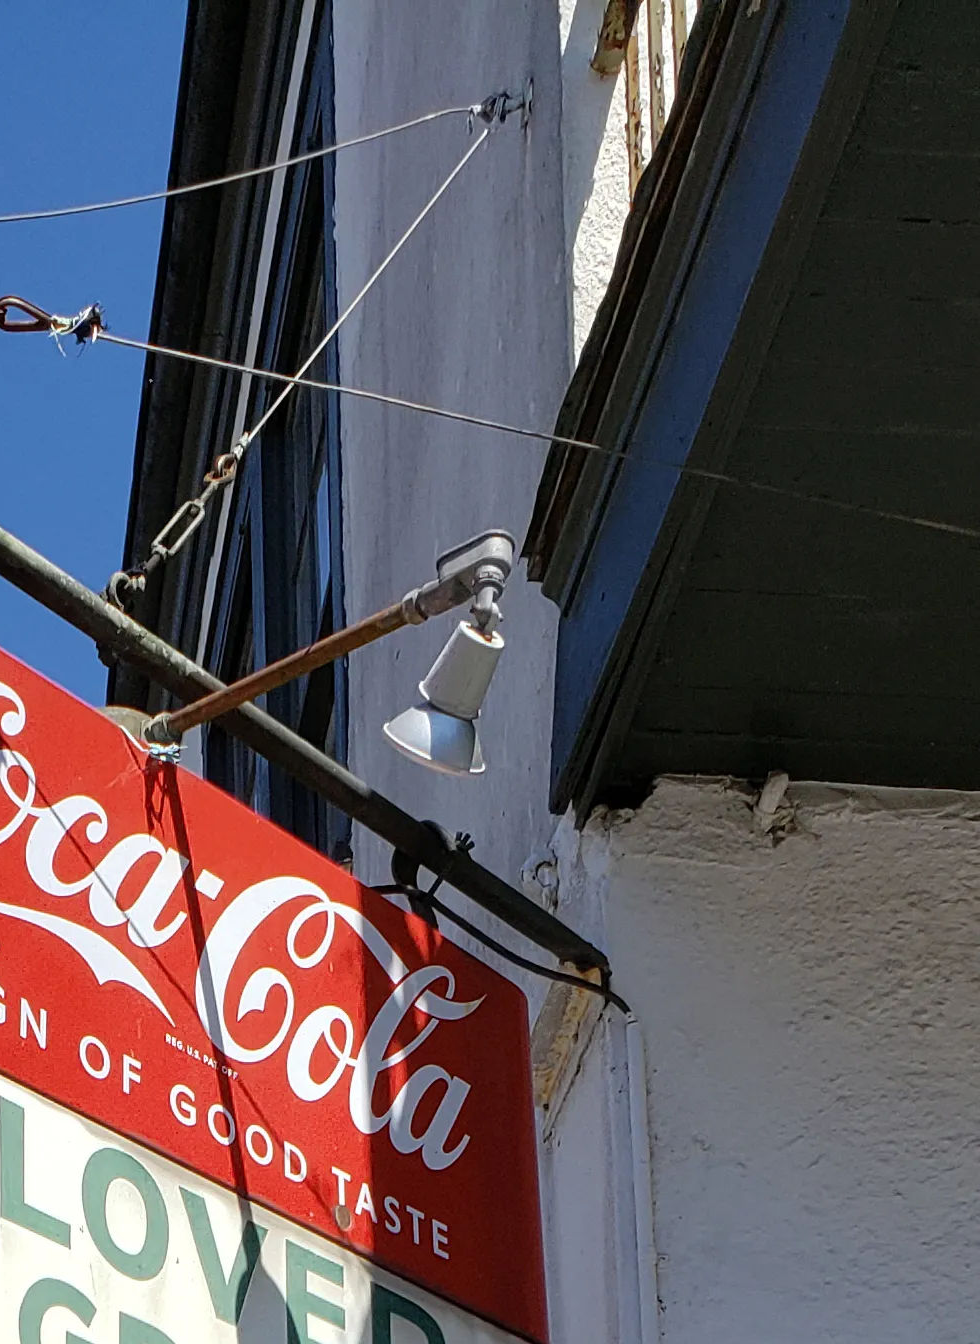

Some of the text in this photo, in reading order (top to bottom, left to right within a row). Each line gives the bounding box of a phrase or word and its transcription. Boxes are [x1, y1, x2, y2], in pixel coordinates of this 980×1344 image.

[78, 1034, 143, 1096] OF
[169, 1084, 308, 1184] GOOD
[331, 1165, 451, 1262] TASTE
